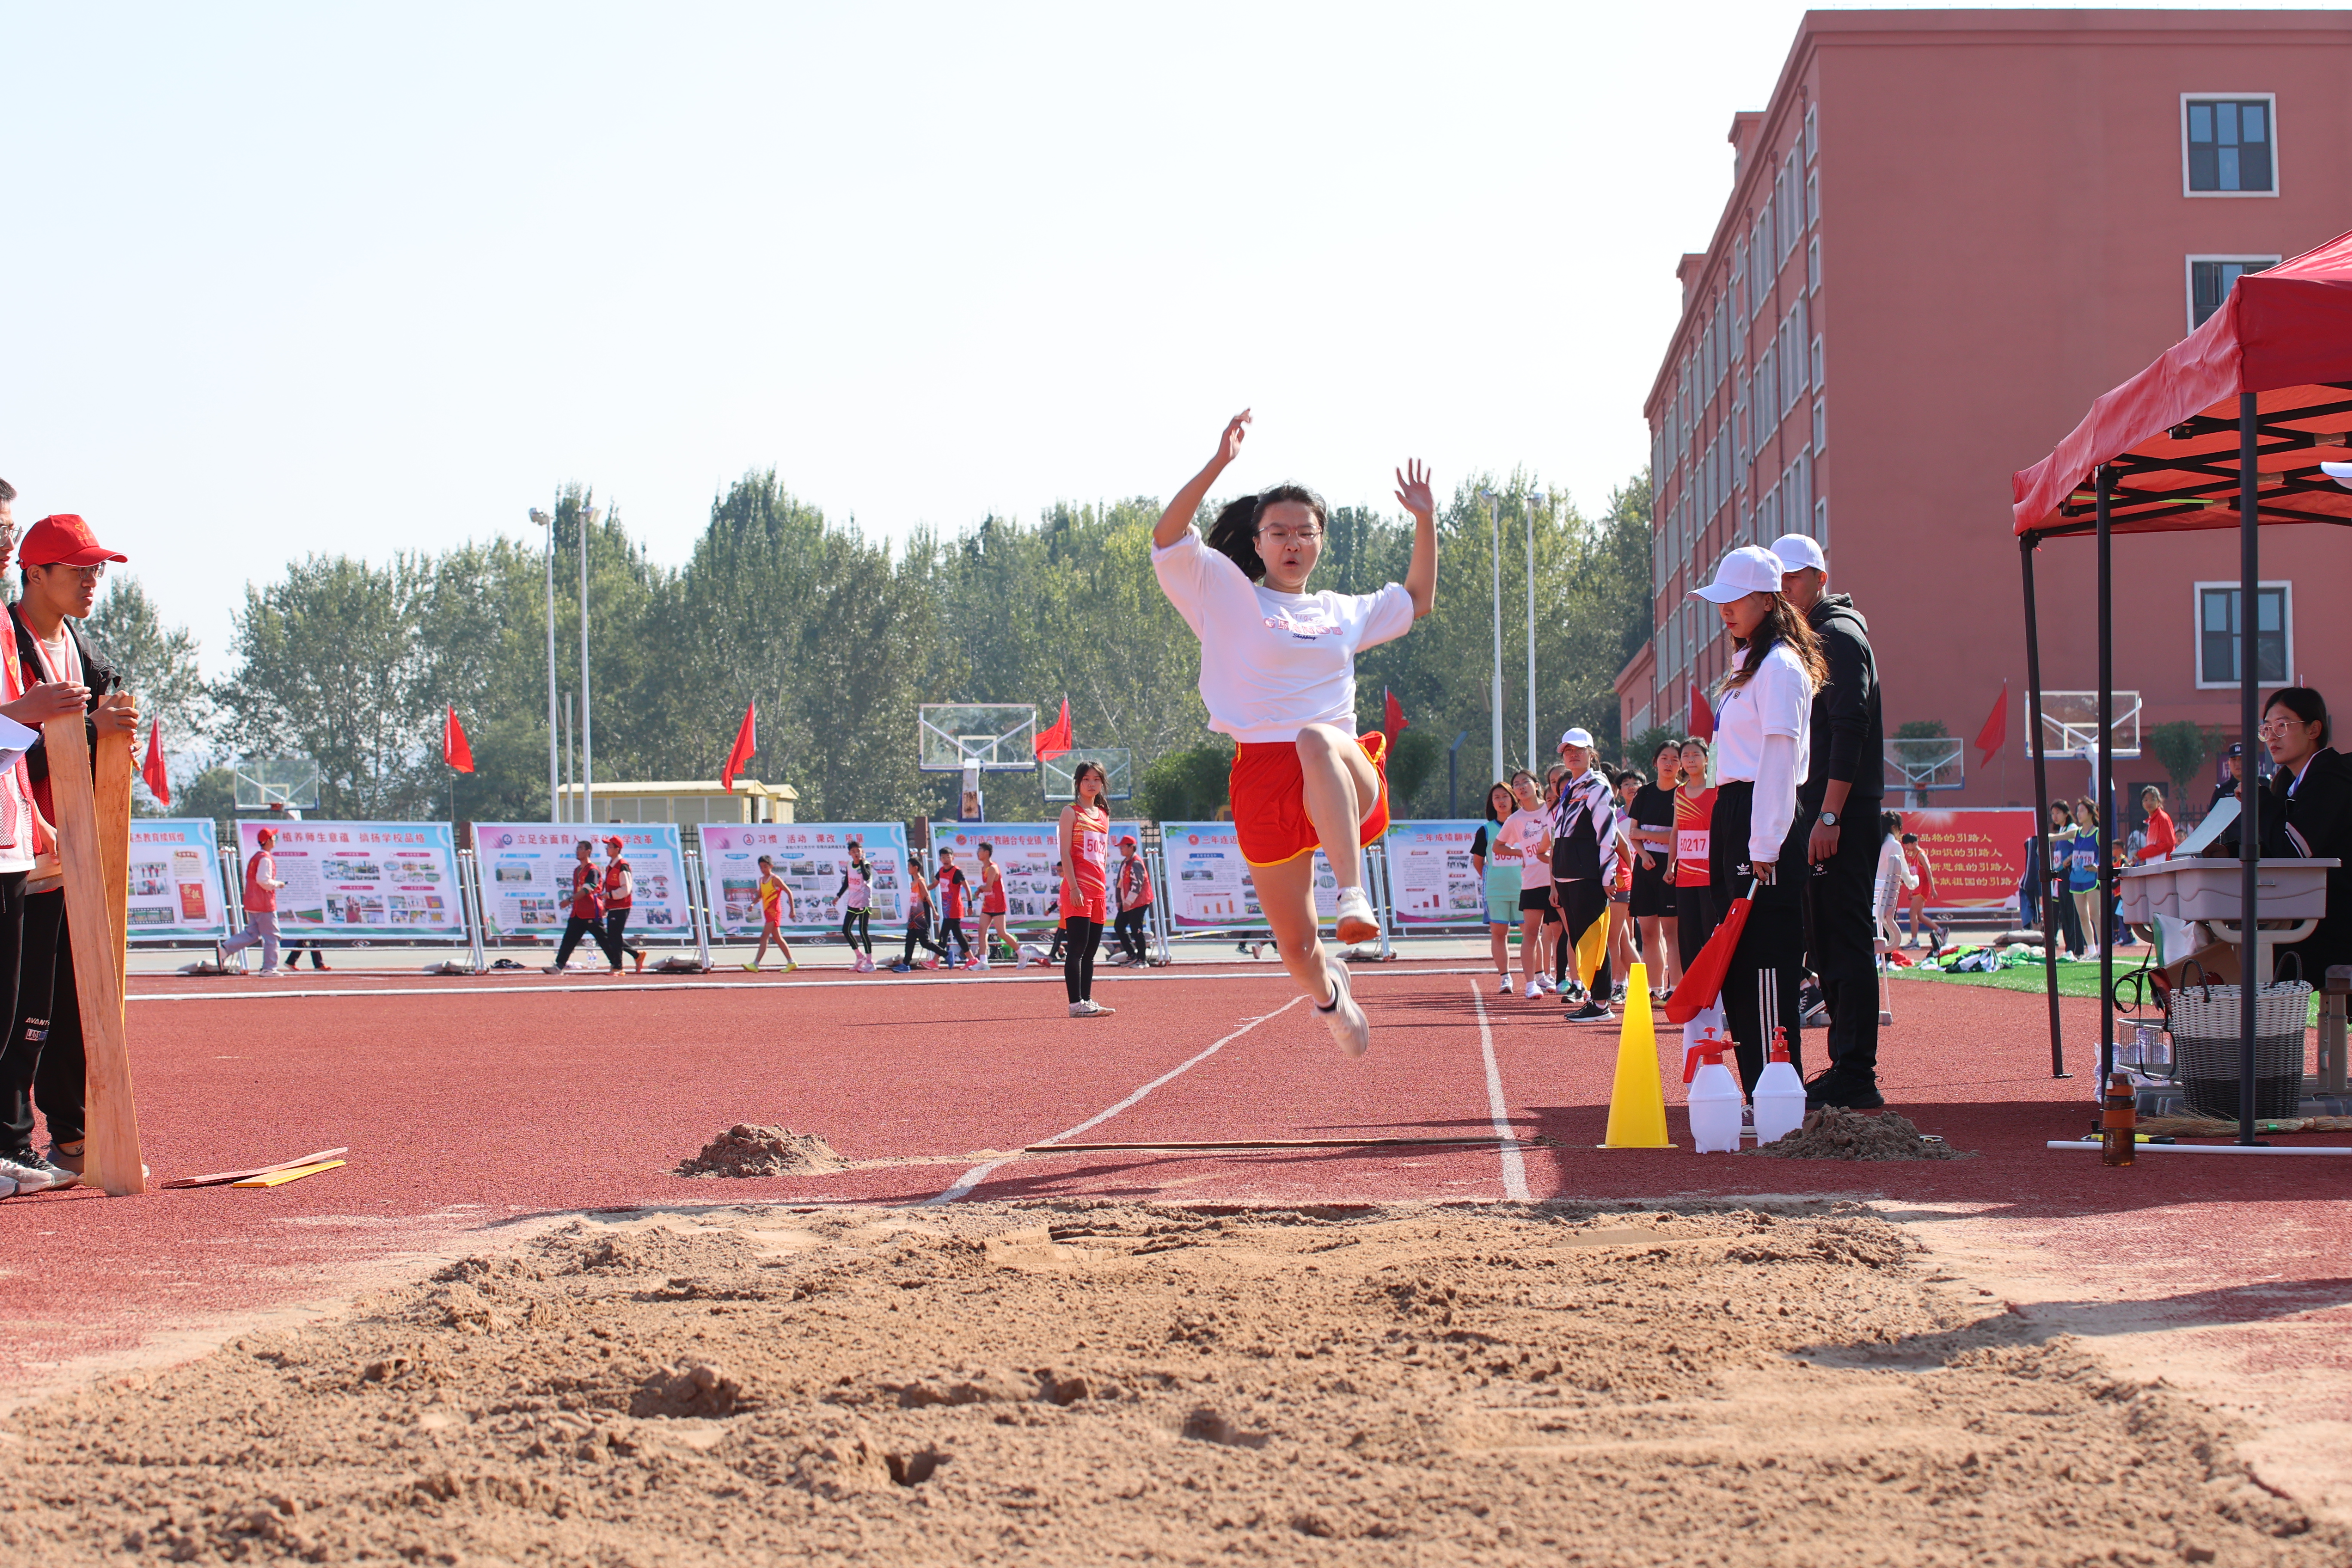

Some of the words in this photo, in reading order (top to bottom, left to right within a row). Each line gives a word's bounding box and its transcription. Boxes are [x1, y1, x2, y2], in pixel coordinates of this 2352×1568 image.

[517, 834, 579, 845] 立足全面育人
[590, 834, 653, 845] 深化学改革
[758, 834, 778, 844] 习惯
[787, 834, 806, 843] 活动
[816, 833, 835, 843] 课改
[845, 833, 864, 843] 质量
[970, 835, 1042, 845] 打造产教融合专业镇
[1202, 835, 1238, 844] 三年连迈
[1416, 833, 1476, 842] 三年成绩翻两
[1896, 833, 1992, 843] 品格的引路人
[1680, 838, 1706, 851] 50217
[27, 1029, 41, 1040] LADS
